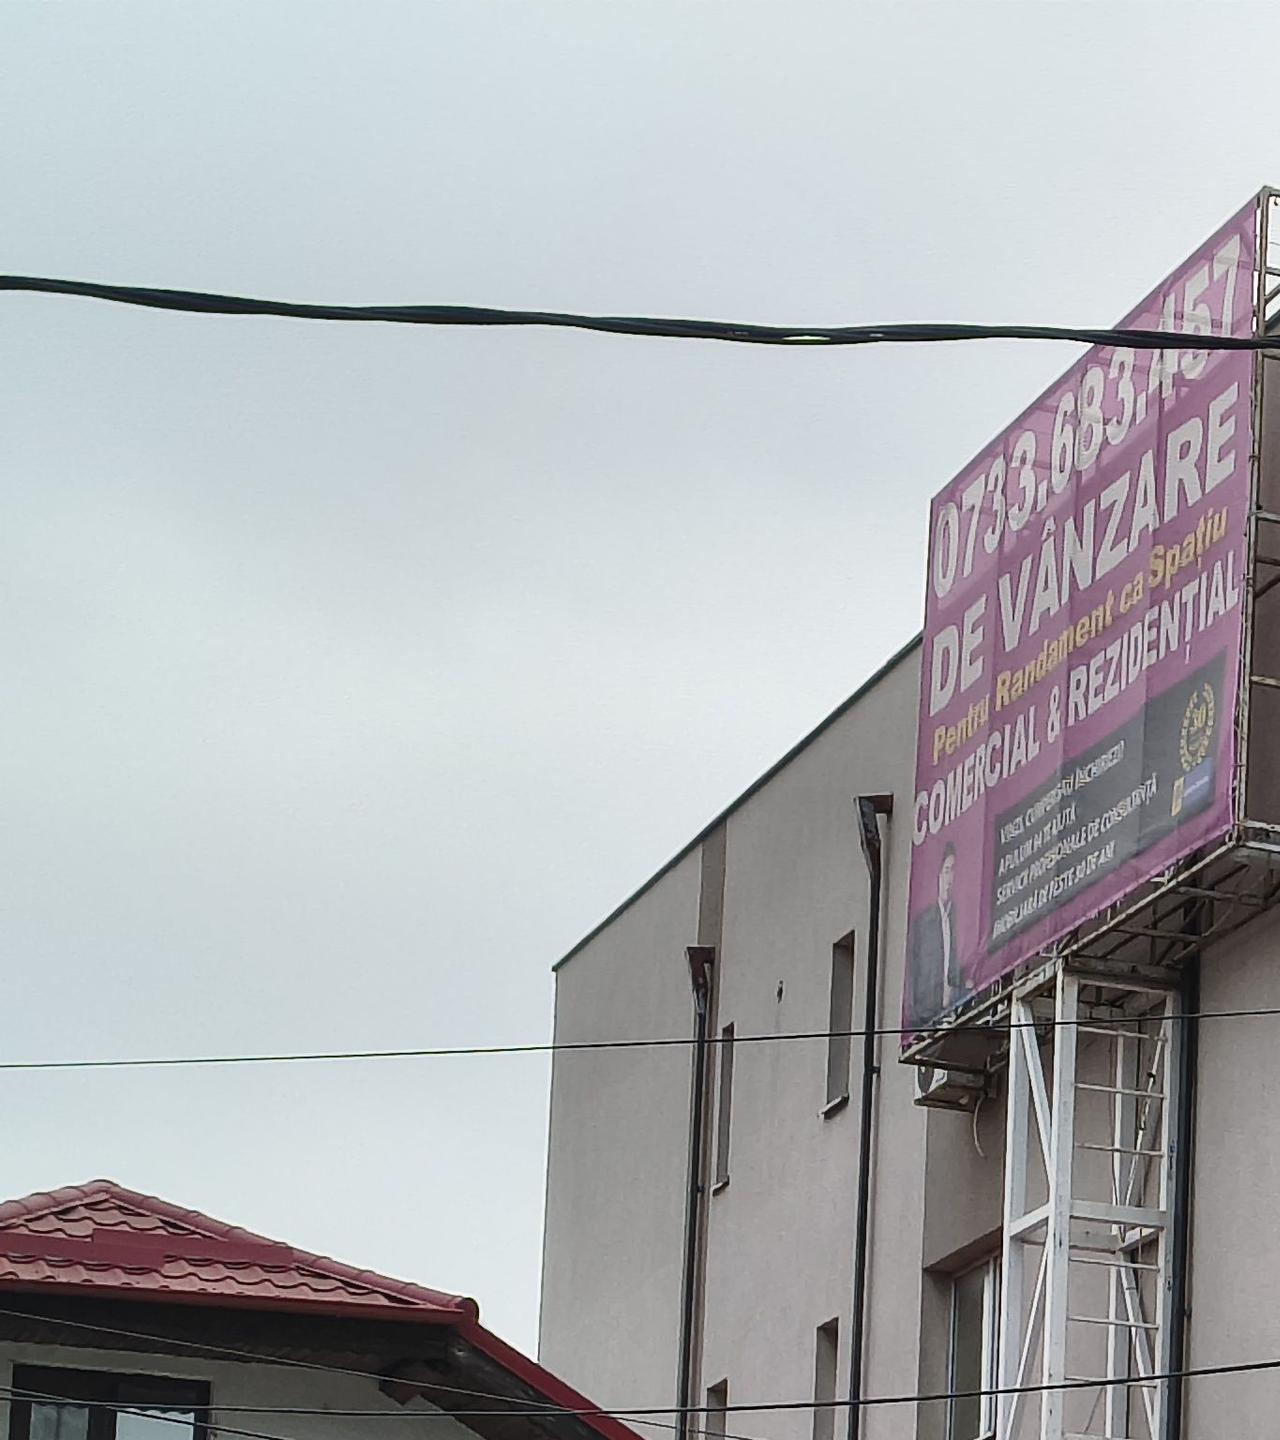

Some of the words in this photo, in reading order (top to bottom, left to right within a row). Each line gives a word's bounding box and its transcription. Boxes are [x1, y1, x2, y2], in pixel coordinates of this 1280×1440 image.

[934, 233, 1240, 598] 0733.683.457
[929, 594, 987, 717] DE
[998, 382, 1239, 653] VÂNZARE
[933, 694, 990, 765] Pentru
[995, 589, 1114, 711] Randament
[1120, 571, 1143, 614] ca
[911, 705, 1041, 846] COMERCIAL
[1047, 685, 1061, 743] &
